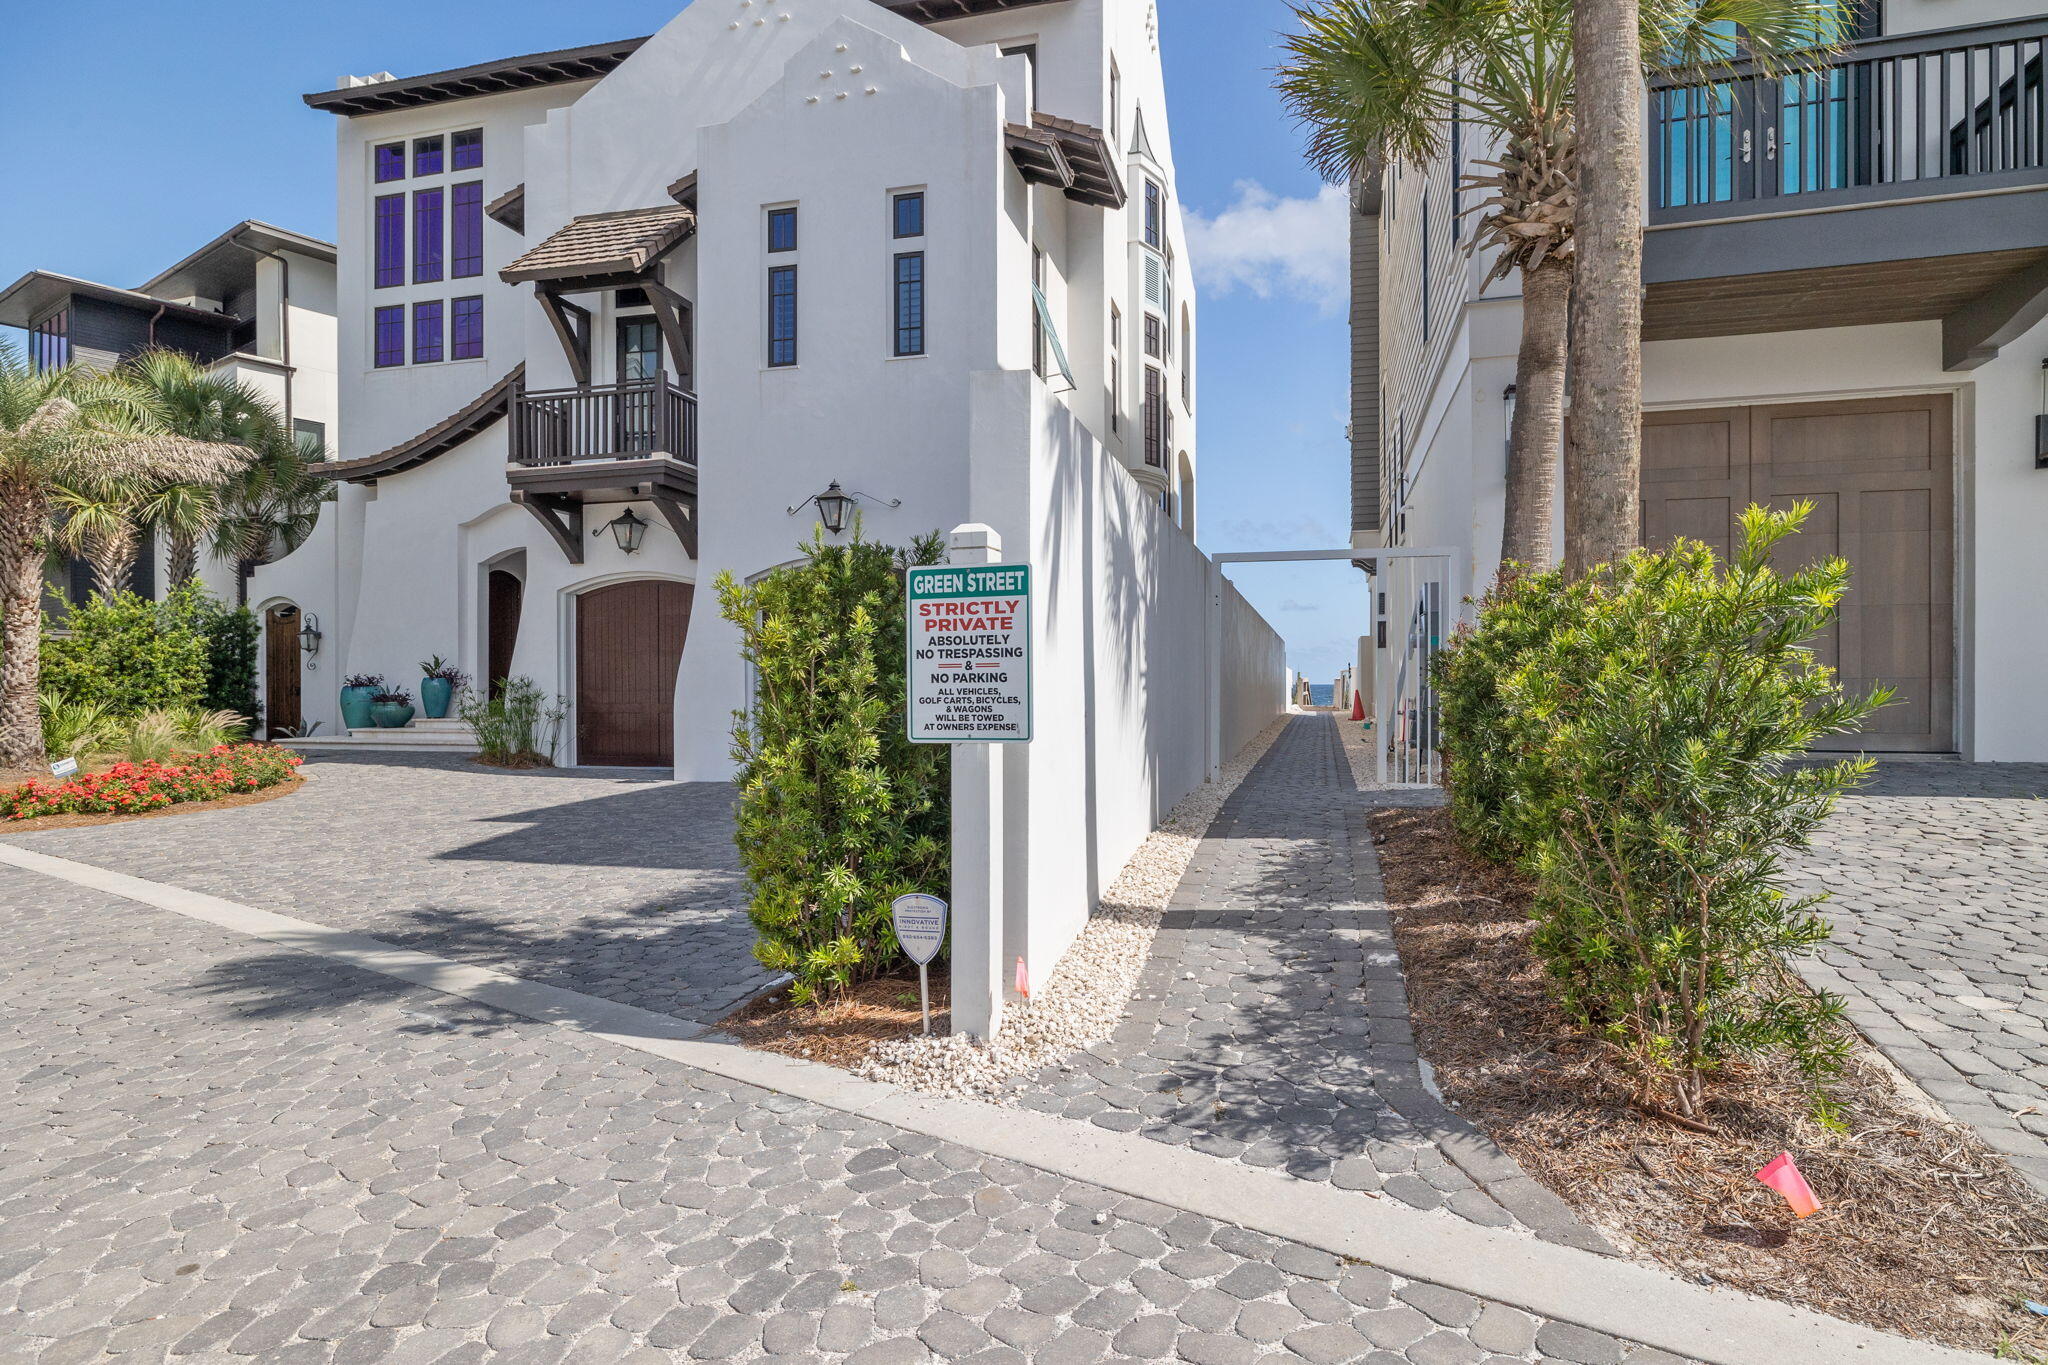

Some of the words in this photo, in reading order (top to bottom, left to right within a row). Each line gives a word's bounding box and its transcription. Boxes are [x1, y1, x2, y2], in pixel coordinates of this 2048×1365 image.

[914, 574, 963, 594] GREEN
[967, 571, 1025, 592] STREET
[919, 600, 1019, 616] STRICTLY
[925, 617, 1013, 632] PRIVATE
[928, 635, 1010, 646] ABSOLUTELY
[916, 649, 934, 660] NO
[938, 647, 1023, 659] TRESPASSING
[965, 661, 973, 670] &
[931, 674, 949, 683] NO
[953, 673, 1008, 683] PARKING
[956, 688, 1001, 696] VEHICLES,
[943, 697, 974, 705] CARTS,
[976, 697, 1021, 705] BICYCLES,
